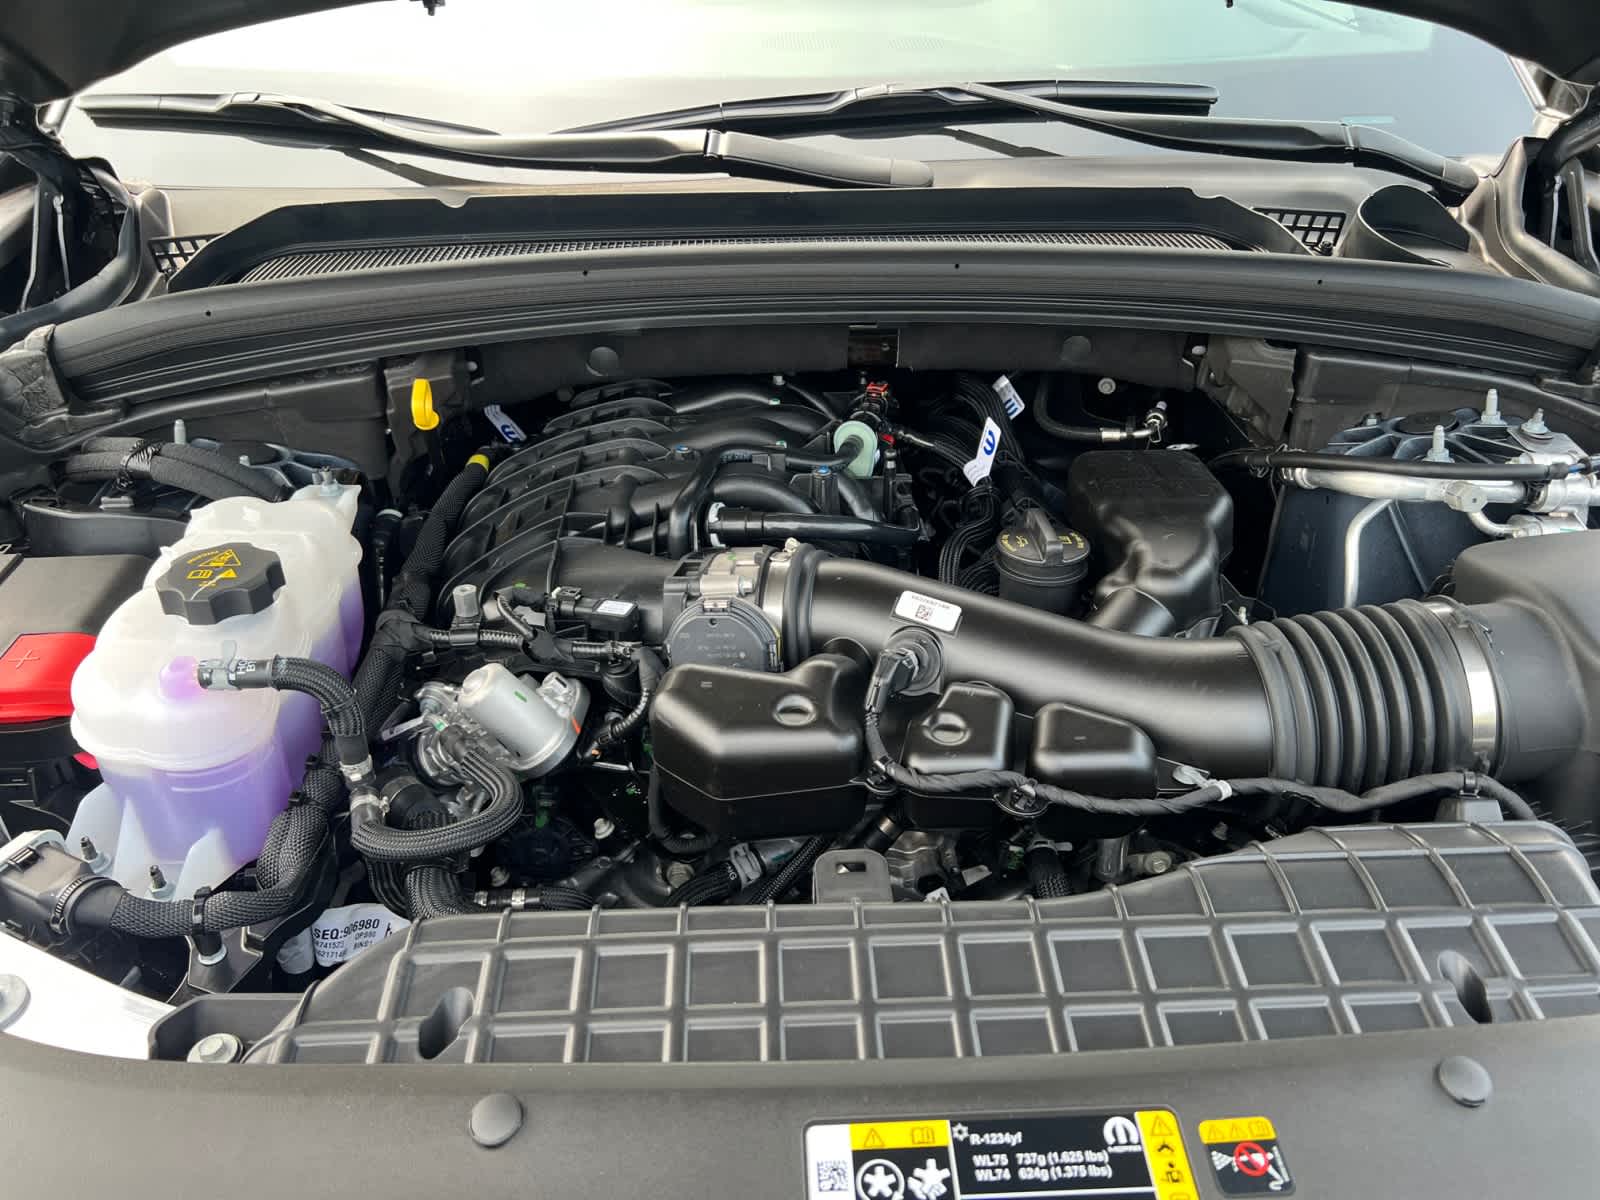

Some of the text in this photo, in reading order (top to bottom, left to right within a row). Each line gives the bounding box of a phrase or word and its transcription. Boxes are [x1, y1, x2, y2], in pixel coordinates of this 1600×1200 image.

[969, 1131, 1022, 1147] R-1234yf
[972, 1154, 1009, 1167] WL75
[1015, 1152, 1047, 1167] 737g
[1084, 1149, 1109, 1163] lbs)
[974, 1168, 1012, 1182] WL74
[1018, 1167, 1050, 1182] 624g
[1087, 1164, 1113, 1179] lbs)
